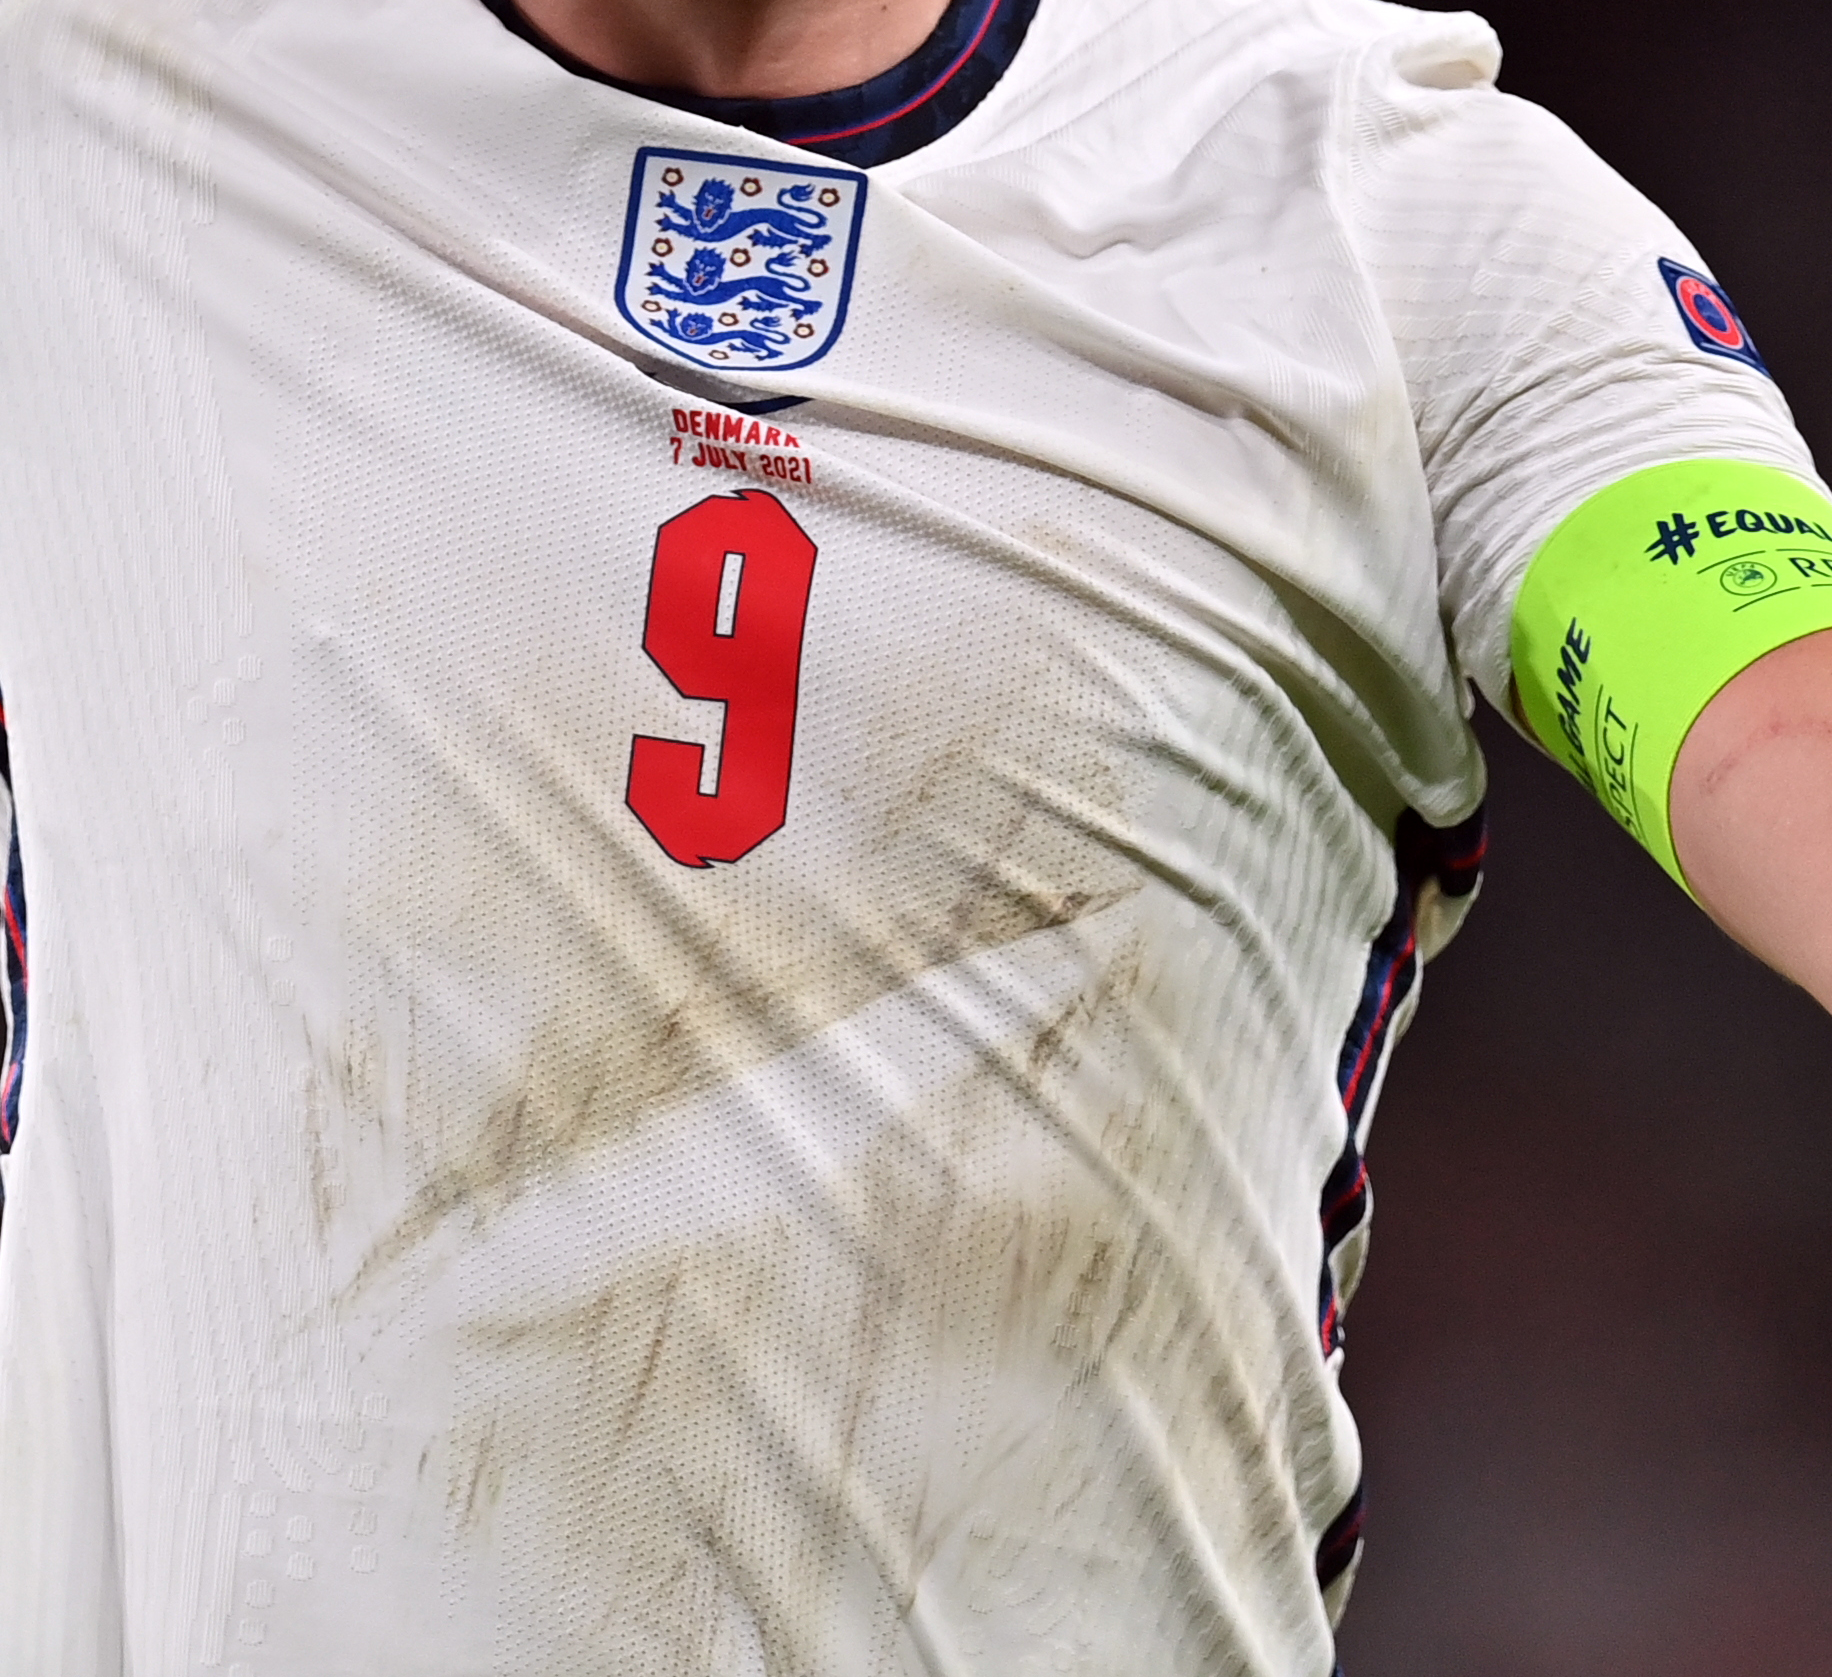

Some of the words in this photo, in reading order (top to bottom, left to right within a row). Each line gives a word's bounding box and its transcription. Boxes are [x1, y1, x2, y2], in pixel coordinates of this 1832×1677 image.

[671, 408, 801, 449] DENMARK
[669, 436, 683, 466] 7
[691, 442, 747, 472] JULY
[759, 454, 812, 485] 2021
[624, 488, 819, 869] 9
